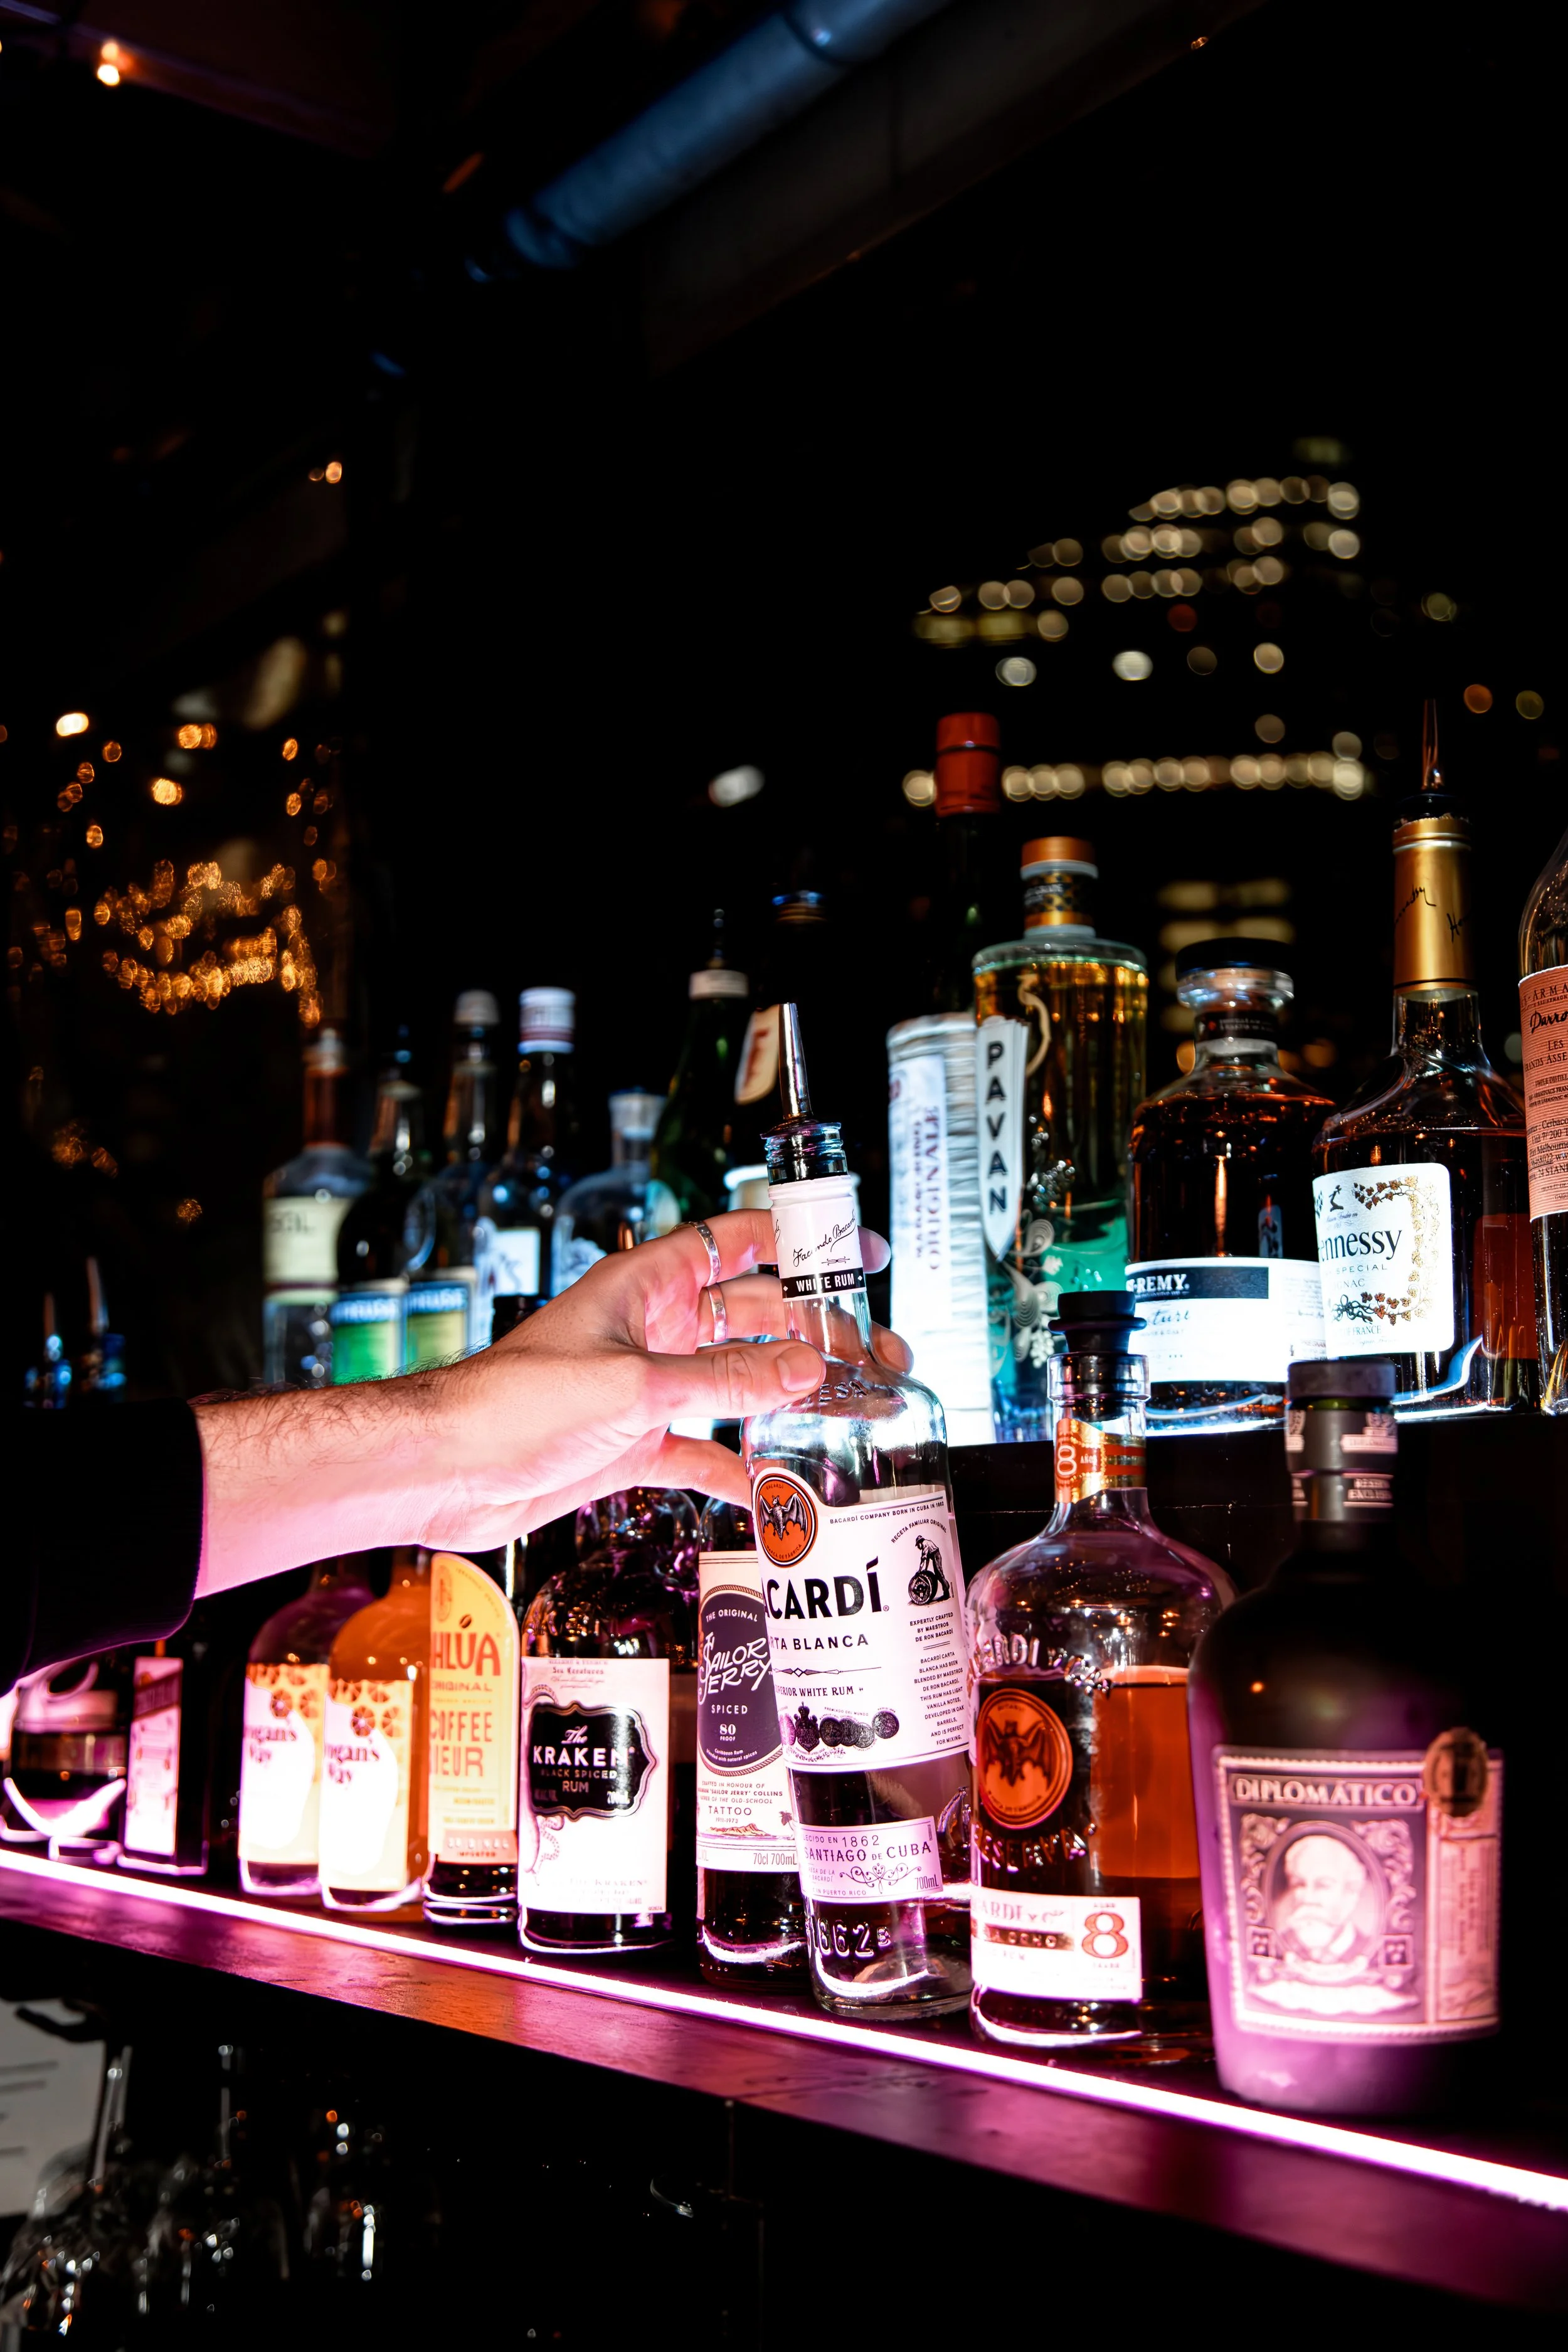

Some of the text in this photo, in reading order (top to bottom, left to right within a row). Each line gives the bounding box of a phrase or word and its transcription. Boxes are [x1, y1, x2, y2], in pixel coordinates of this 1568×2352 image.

[1547, 1040, 1564, 1051] LES
[985, 1040, 1008, 1215] PAVAN
[1336, 1264, 1387, 1274] SPECIAL
[796, 1273, 854, 1292] WHITE RUM
[1352, 1325, 1381, 1336] FRANCE
[1057, 1444, 1077, 1476] 8
[830, 1516, 858, 1524] BACARDÍ
[860, 1512, 891, 1520] COMPANY
[891, 1518, 946, 1543] RECETA FAMILIAR ORIGINAL
[706, 1609, 758, 1623] THE ORIGINAL
[910, 1612, 953, 1626] EXPERTLY CRAFTED
[925, 1621, 949, 1631] MAESTROS
[935, 1628, 953, 1638] BACARDÍ
[793, 1634, 868, 1650] BLANCA
[699, 1632, 768, 1683] SAILOR
[921, 1654, 941, 1663] BACARDÍ
[919, 1665, 938, 1673] BLANCA
[914, 1675, 936, 1683] BLENDED
[943, 1668, 963, 1677] MAESTROS
[698, 1659, 771, 1705] JERRY
[799, 1687, 828, 1697] WHITE
[832, 1686, 854, 1696] RUM
[711, 1704, 748, 1714] SPICED
[926, 1697, 961, 1709] VANILLA NOTES,
[924, 1709, 951, 1719] DEVELOPED
[430, 1709, 492, 1742] COFFEE
[937, 1717, 958, 1726] BARRELS,
[561, 1725, 588, 1744] The
[719, 1724, 736, 1735] 80
[947, 1724, 964, 1733] PERFECT
[946, 1735, 962, 1743] MIXING.
[533, 1745, 629, 1767] KRAKEN
[743, 1750, 758, 1760] spices
[575, 1769, 618, 1779] SPICED
[562, 1780, 589, 1793] RUM
[1236, 1779, 1417, 1806] DIPLOMÁTICO
[708, 1806, 752, 1815] TATTOO
[842, 1835, 879, 1847] 1862
[804, 1846, 866, 1862] SANTIAGO
[886, 1841, 931, 1858] CUBA
[753, 1853, 797, 1865] 70cl 700mL
[914, 1874, 939, 1890] 700mL
[1081, 1910, 1128, 1959] 8
